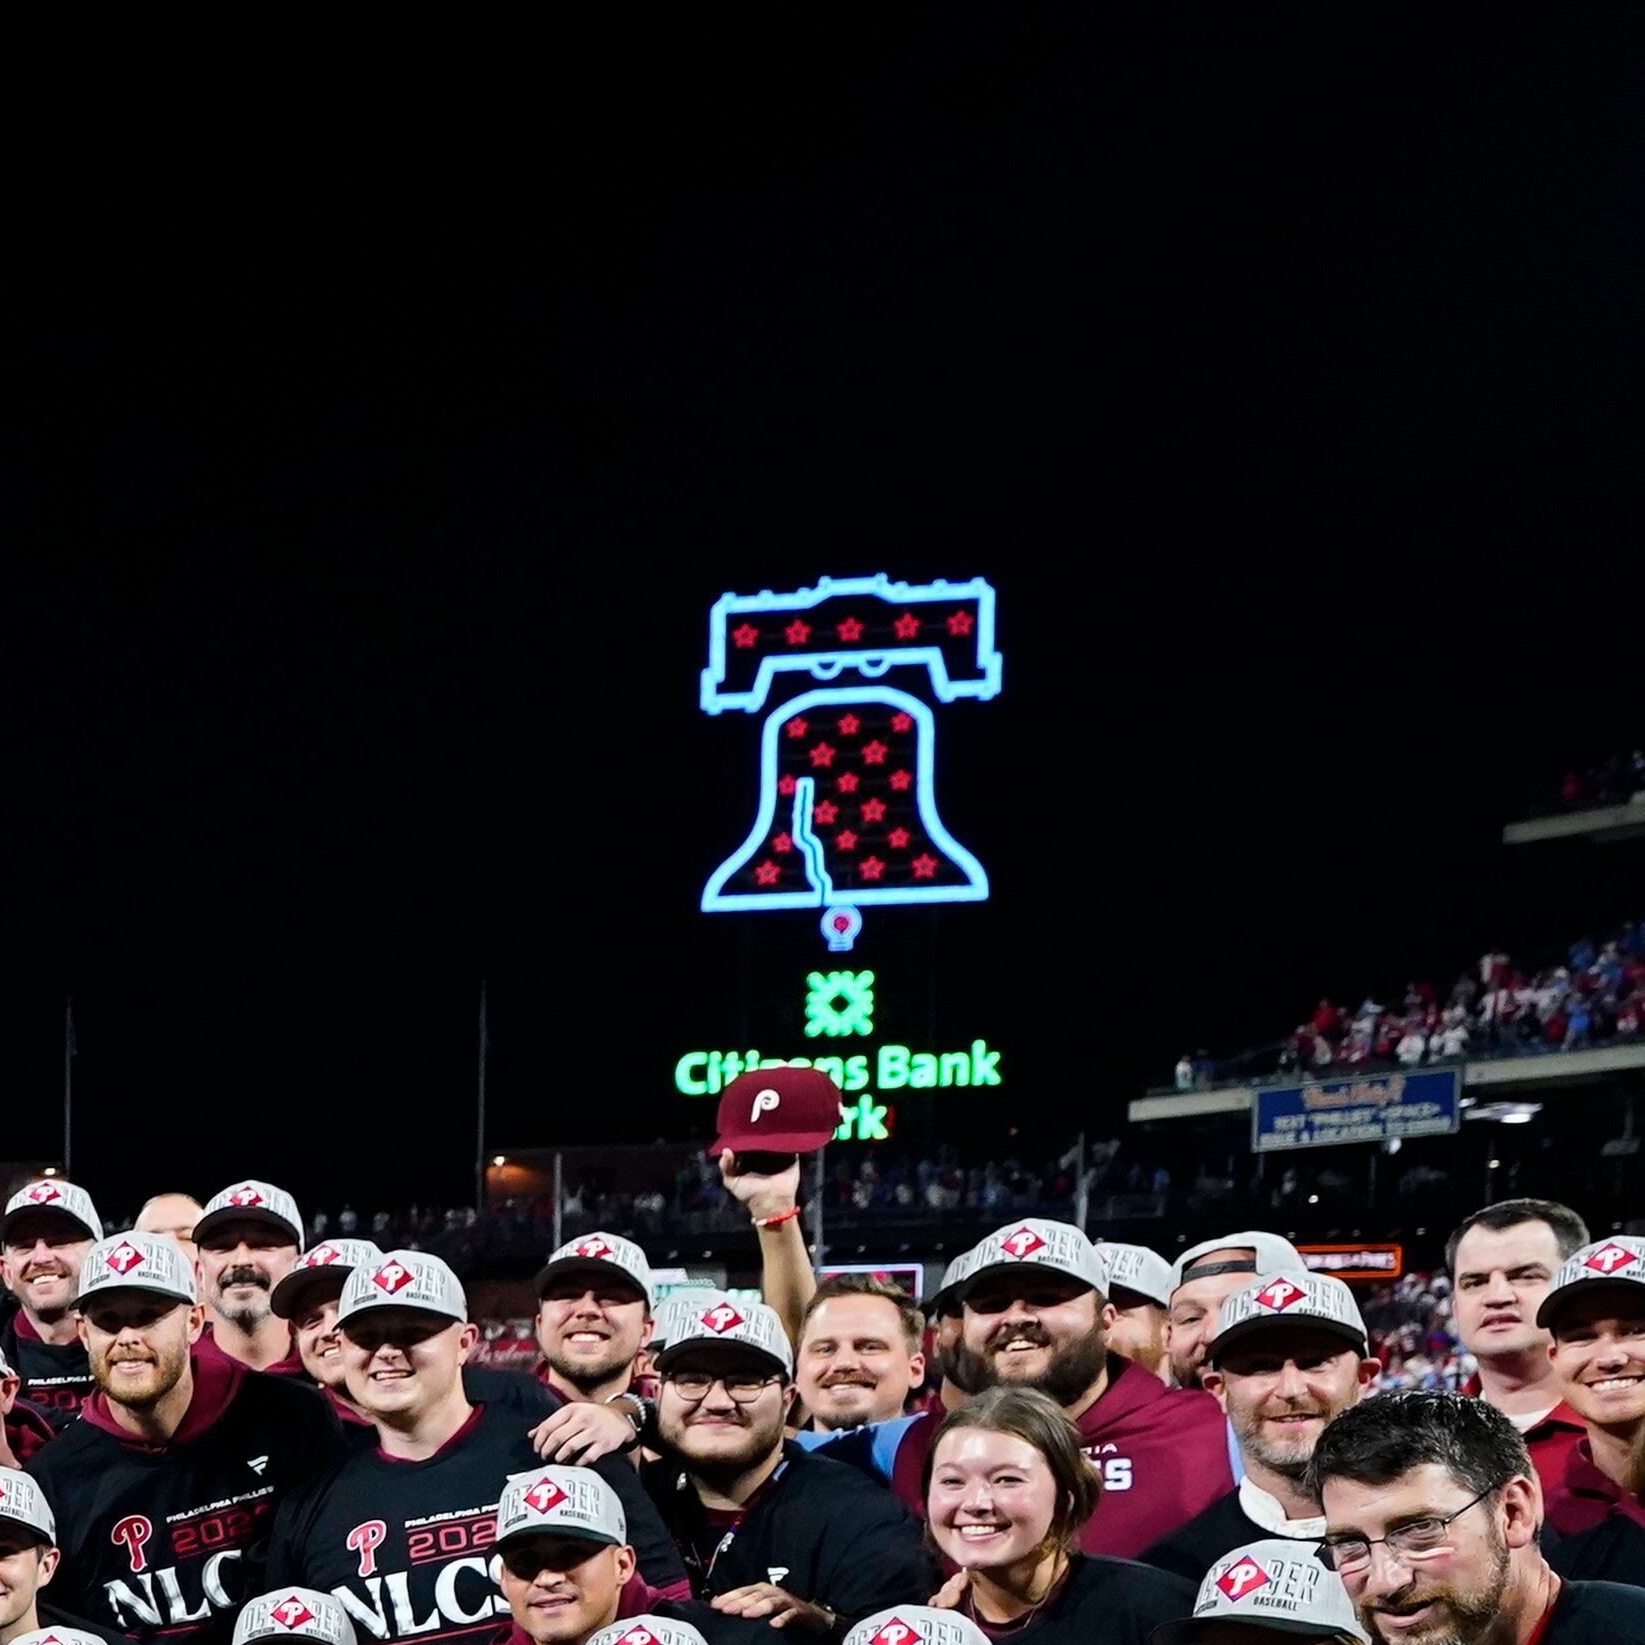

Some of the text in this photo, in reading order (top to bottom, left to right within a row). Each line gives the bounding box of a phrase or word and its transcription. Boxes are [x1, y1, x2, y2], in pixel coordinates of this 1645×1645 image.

[877, 1039, 1002, 1090] Bank
[750, 1088, 781, 1123] P
[165, 1498, 231, 1525] PHILADELPHIA
[404, 1506, 471, 1528] PHILADELPHIA
[111, 1515, 153, 1573] P
[346, 1518, 388, 1578] P
[103, 1548, 244, 1629] NLC
